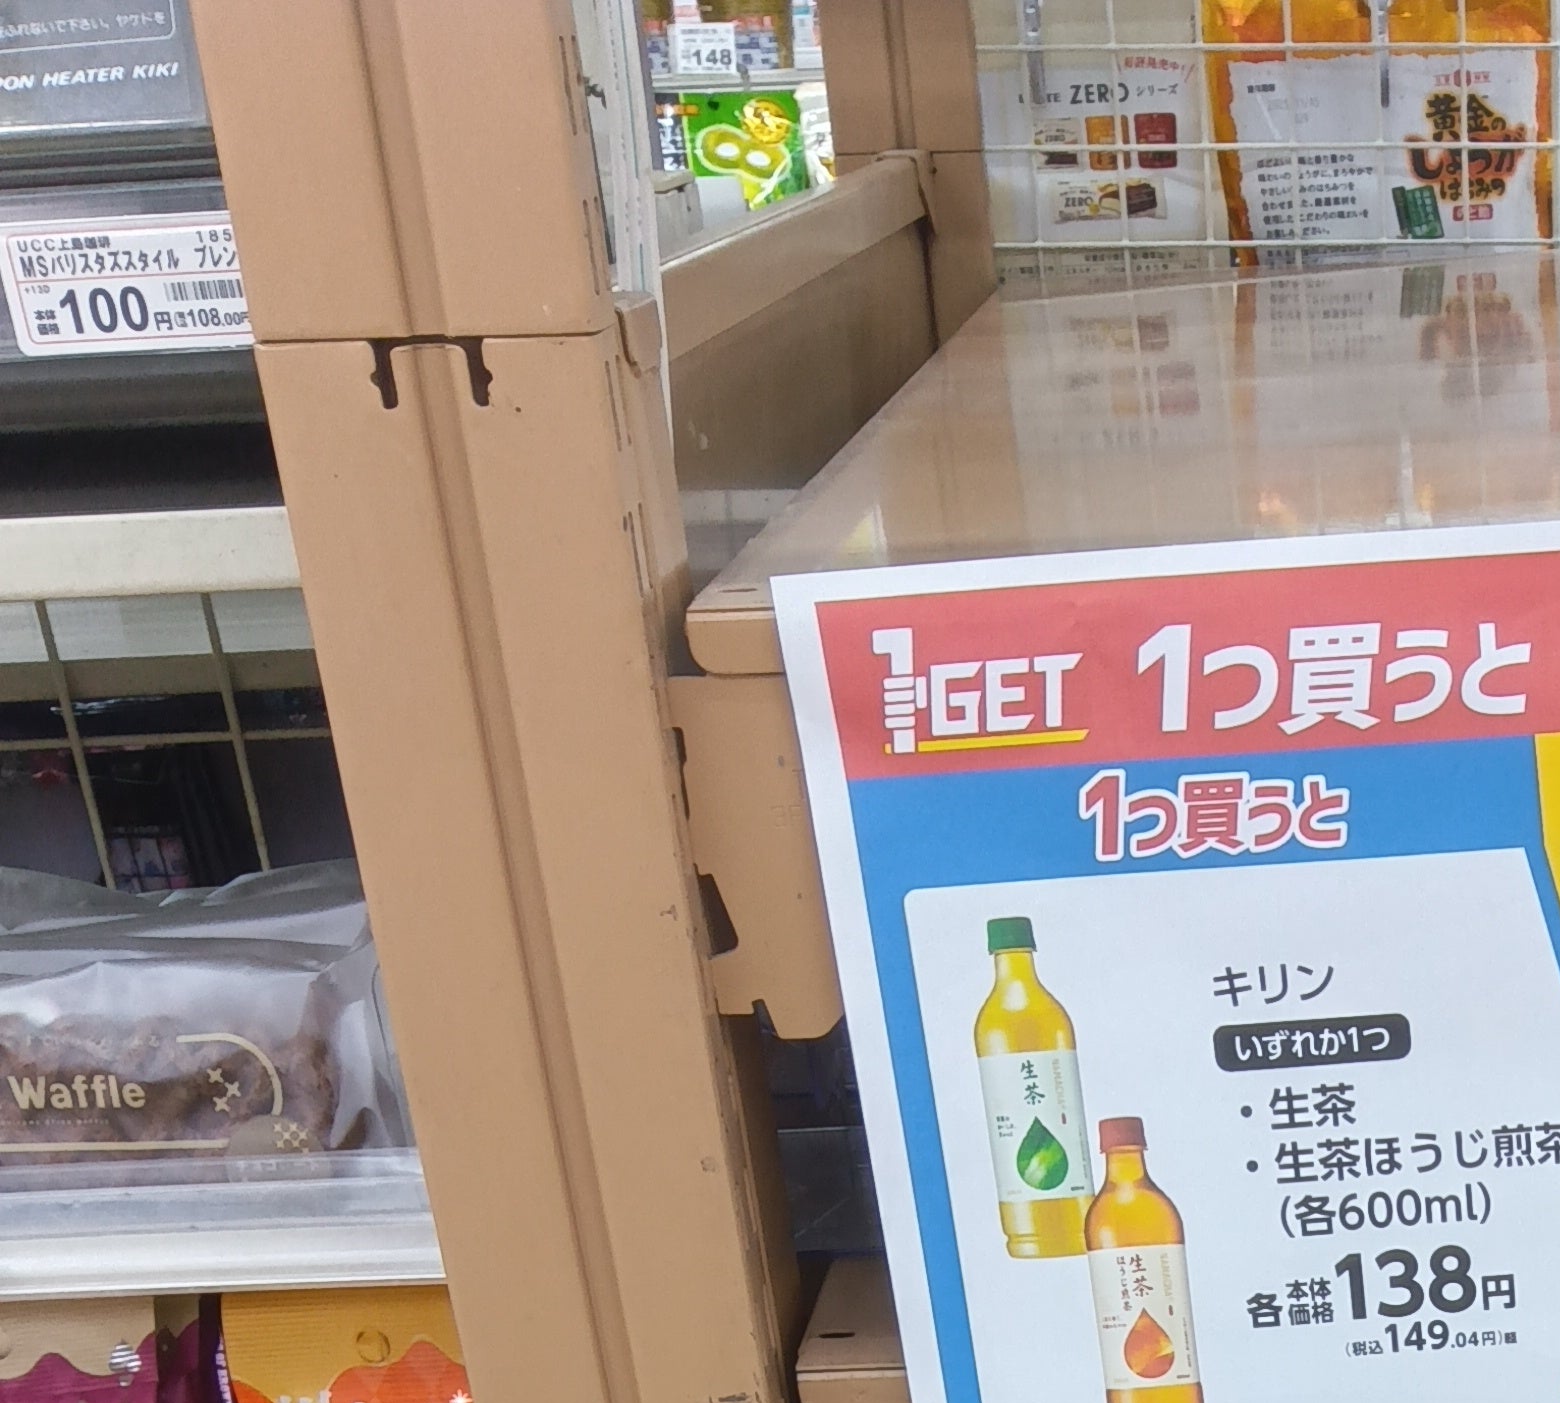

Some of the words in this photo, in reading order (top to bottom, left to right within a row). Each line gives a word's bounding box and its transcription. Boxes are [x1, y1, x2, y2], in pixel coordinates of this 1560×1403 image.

[42, 66, 125, 87] HEATER
[132, 62, 179, 79] KIKI
[692, 50, 732, 65] 148
[1070, 83, 1129, 104] ZERO
[1136, 83, 1179, 97] シリーズ
[19, 249, 180, 277] MSバリスタズスタイル
[1135, 621, 1533, 736] 1つ買うと
[1080, 772, 1350, 859] 1つ買うと
[1212, 963, 1336, 1007] キリン
[1233, 1026, 1391, 1062] いずれか1つ
[7, 1074, 147, 1111] Waffle
[1020, 1059, 1045, 1106] 生茶
[1278, 1182, 1493, 1241] (各600ml)
[1129, 1254, 1154, 1298] 生茶
